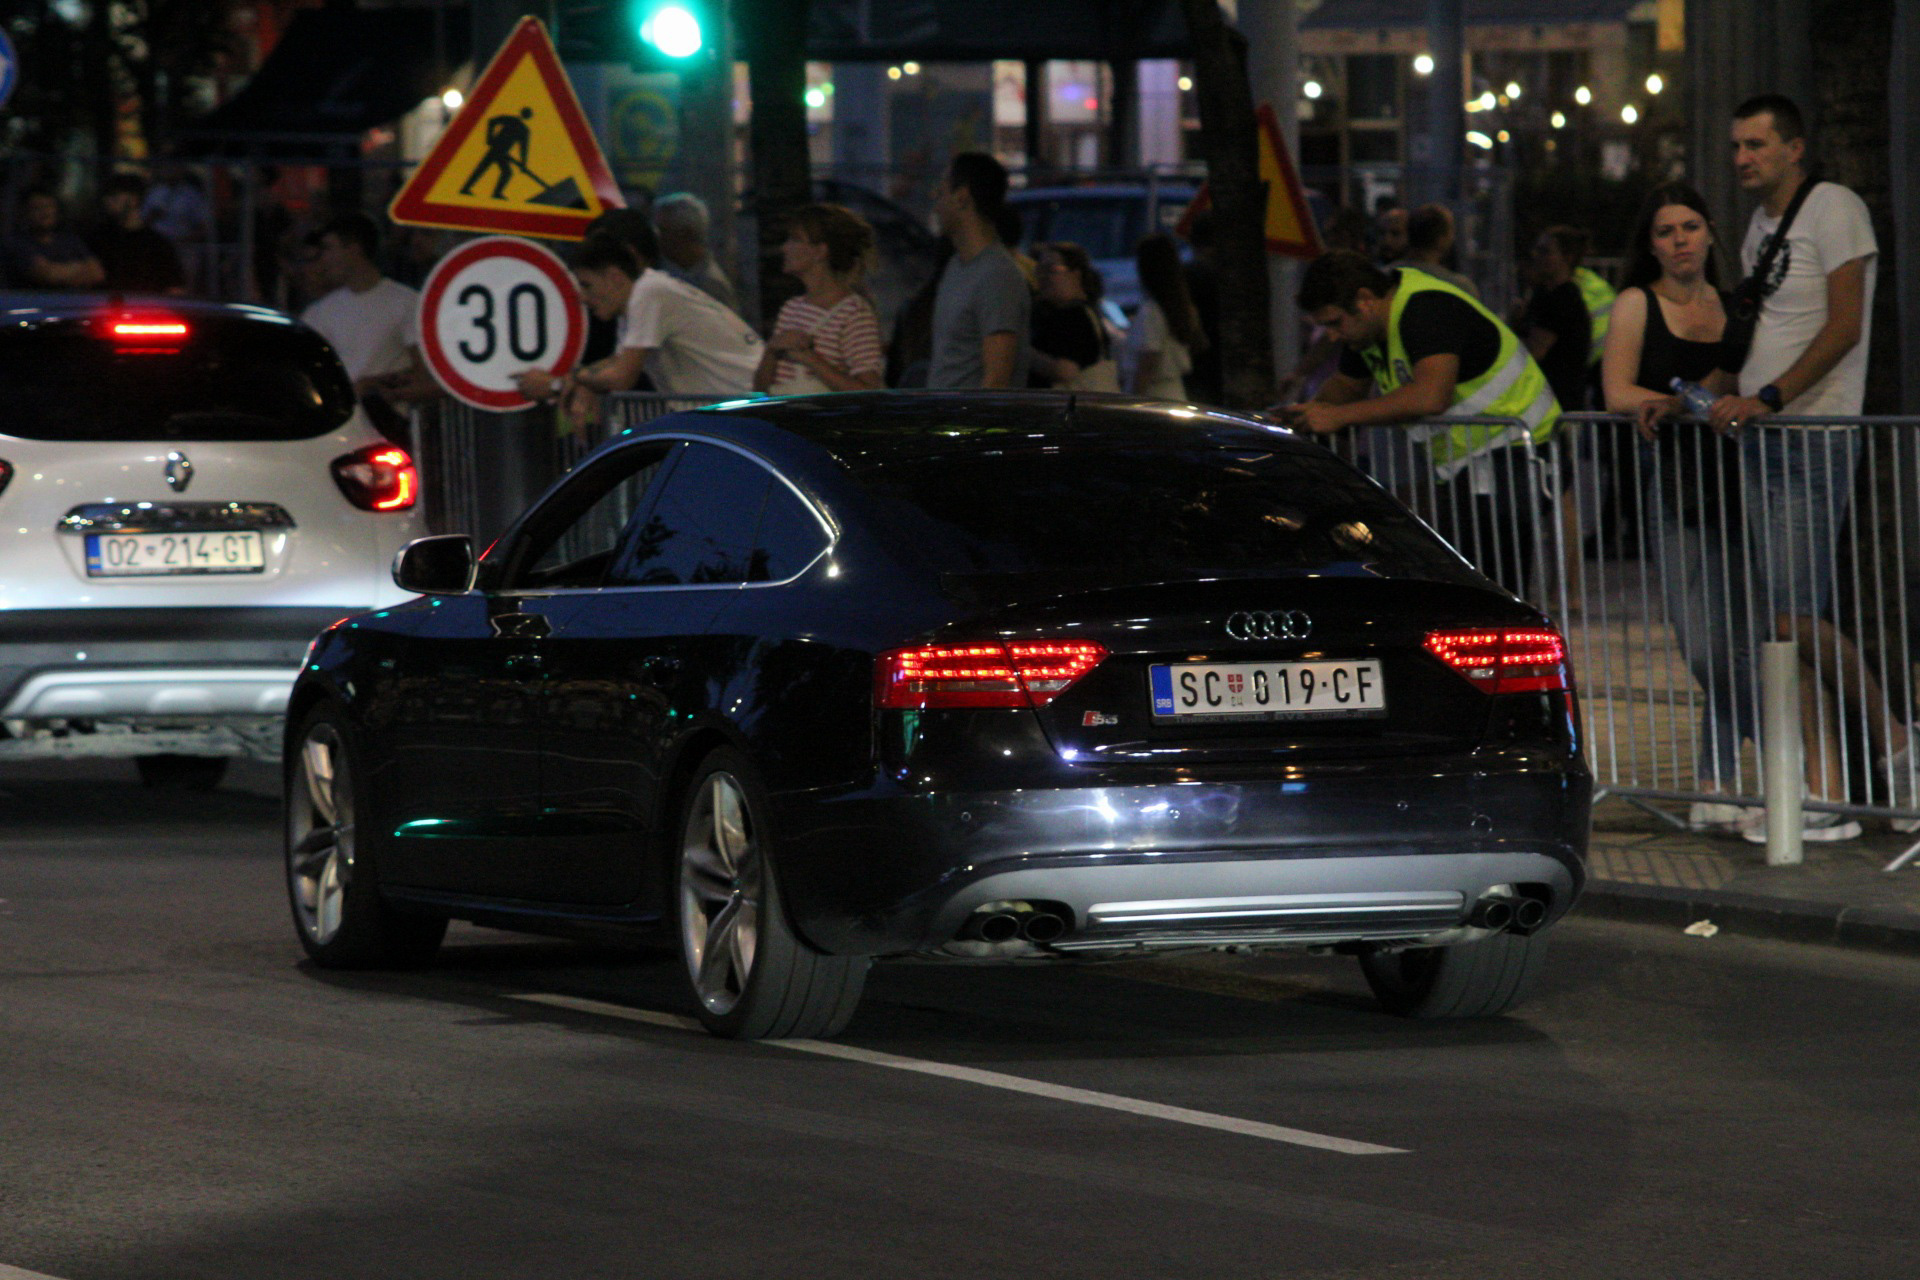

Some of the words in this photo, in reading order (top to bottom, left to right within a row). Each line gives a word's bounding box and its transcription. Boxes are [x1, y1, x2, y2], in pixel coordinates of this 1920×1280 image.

[458, 282, 547, 364] 30
[107, 539, 141, 566] 02
[1180, 671, 1222, 707] SC
